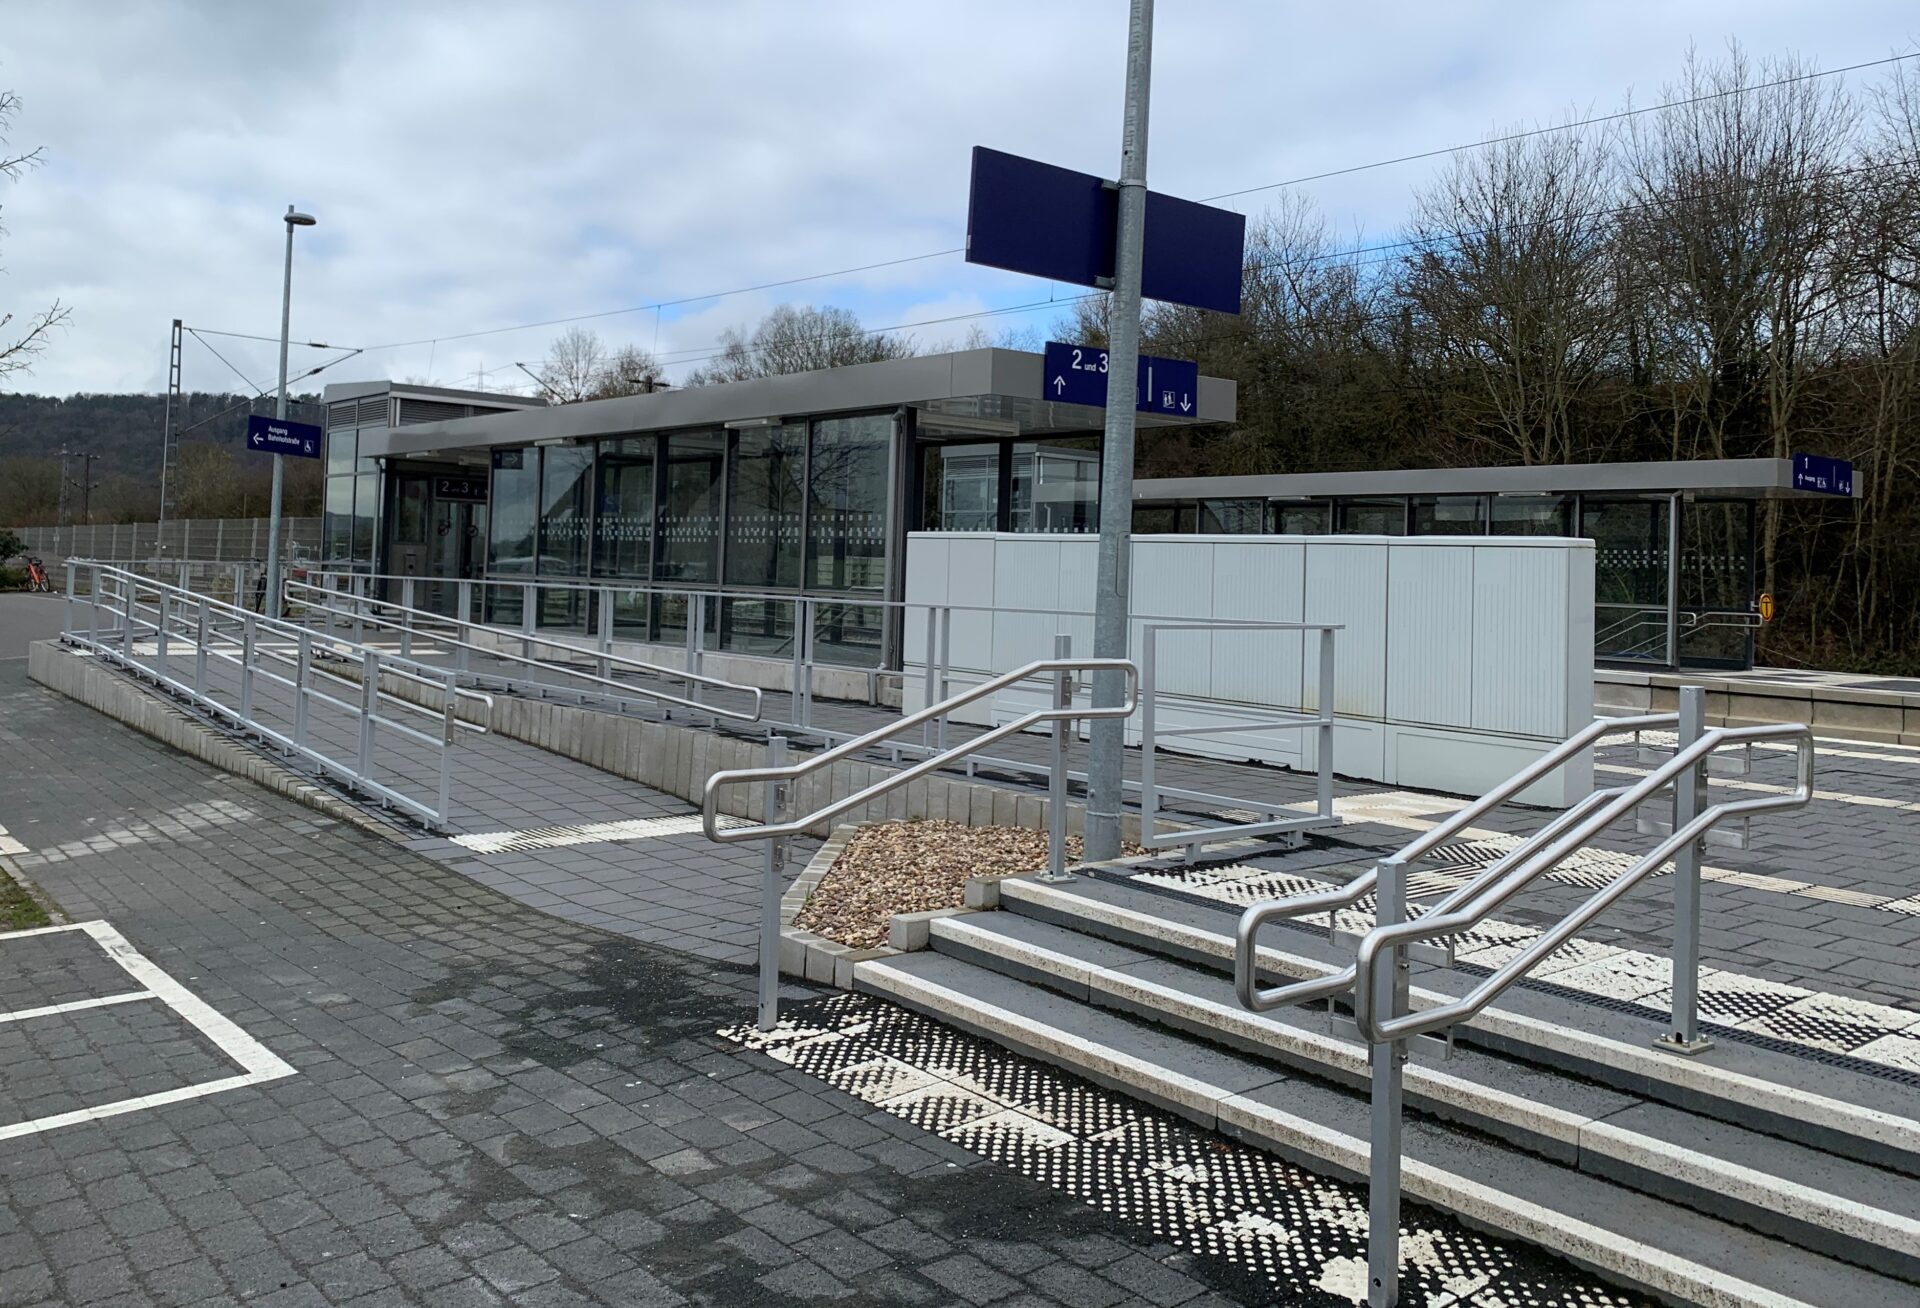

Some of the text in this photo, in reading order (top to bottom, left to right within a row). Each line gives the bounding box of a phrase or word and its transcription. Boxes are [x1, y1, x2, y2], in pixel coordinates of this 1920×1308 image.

[1072, 349, 1108, 373] 2 und 3
[268, 425, 288, 436] Ausgang
[1804, 457, 1808, 469] 1
[442, 481, 449, 492] 2
[461, 482, 469, 493] 3
